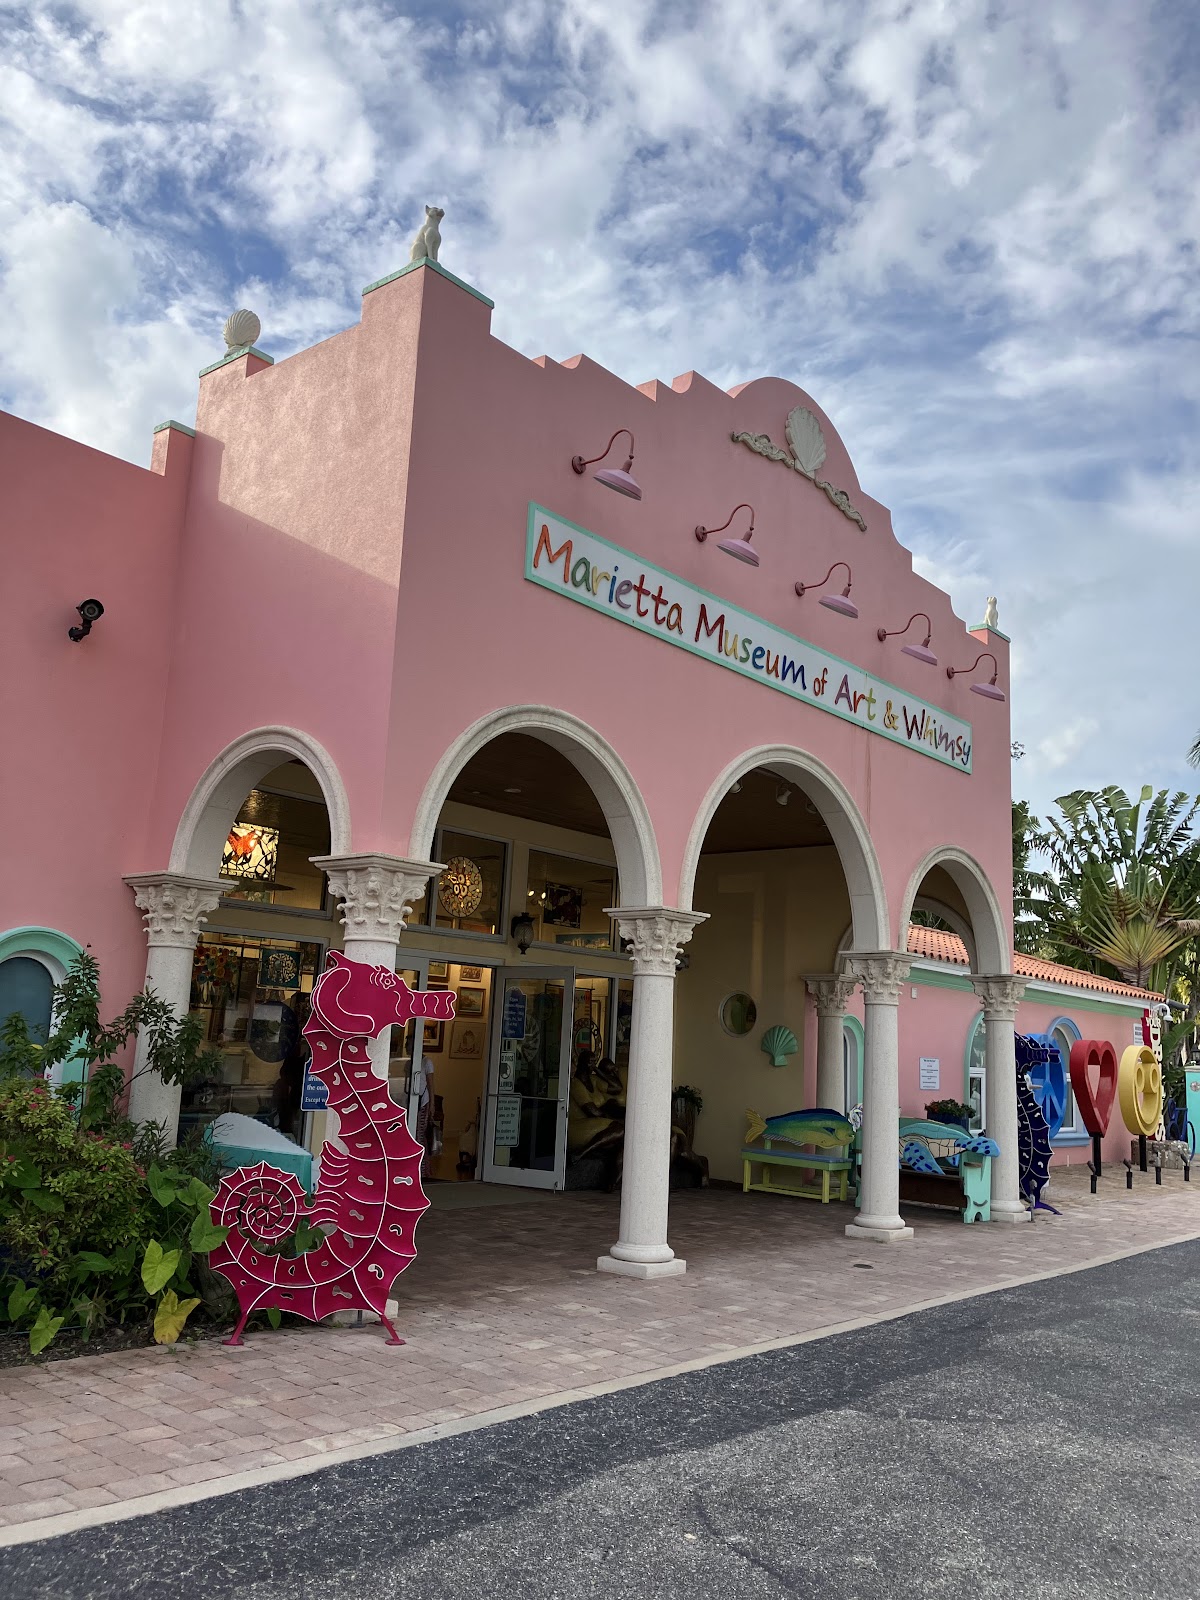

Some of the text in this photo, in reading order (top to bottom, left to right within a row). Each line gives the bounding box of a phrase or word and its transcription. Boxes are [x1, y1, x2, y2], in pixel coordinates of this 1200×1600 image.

[533, 524, 971, 765] Marietta Museum of Art & Whimsy
